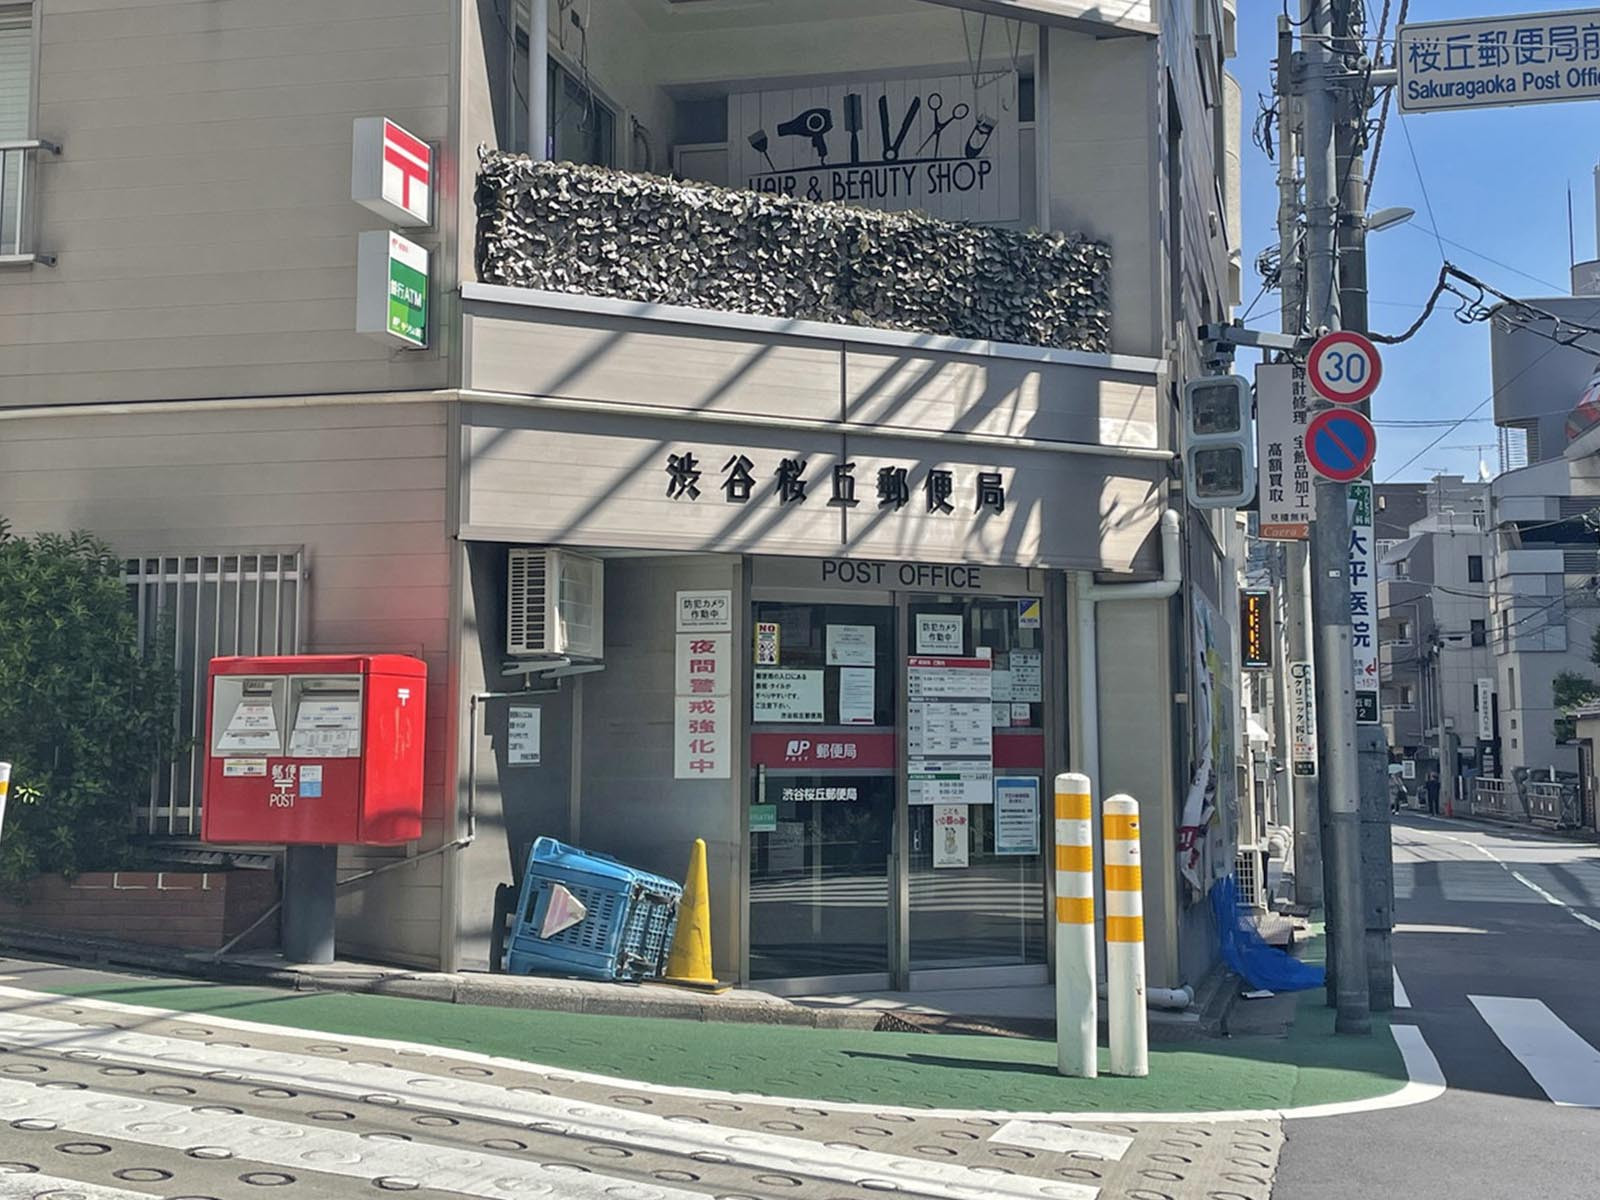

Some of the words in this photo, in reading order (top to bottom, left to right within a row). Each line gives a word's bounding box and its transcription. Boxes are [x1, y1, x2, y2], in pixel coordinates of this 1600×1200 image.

[1408, 75, 1516, 100] Sakuragaoka
[1522, 70, 1561, 91] Post
[806, 175, 823, 201] &
[832, 166, 916, 200] BEAUTY
[928, 160, 992, 194] SHOP
[1325, 351, 1365, 384] 30
[665, 451, 1006, 516] 渋谷桜丘郵便局
[1268, 442, 1284, 503] 高額買取
[822, 559, 886, 584] POST
[898, 564, 981, 589] OFFICE
[684, 599, 725, 609] 防犯カメラ
[691, 610, 719, 620] 作動中
[759, 624, 776, 632] NO
[689, 639, 716, 774] 夜間警戒強化中
[816, 743, 857, 759] 郵便局
[269, 793, 296, 808] POST
[782, 787, 858, 801] 渋谷桜丘郵便局
